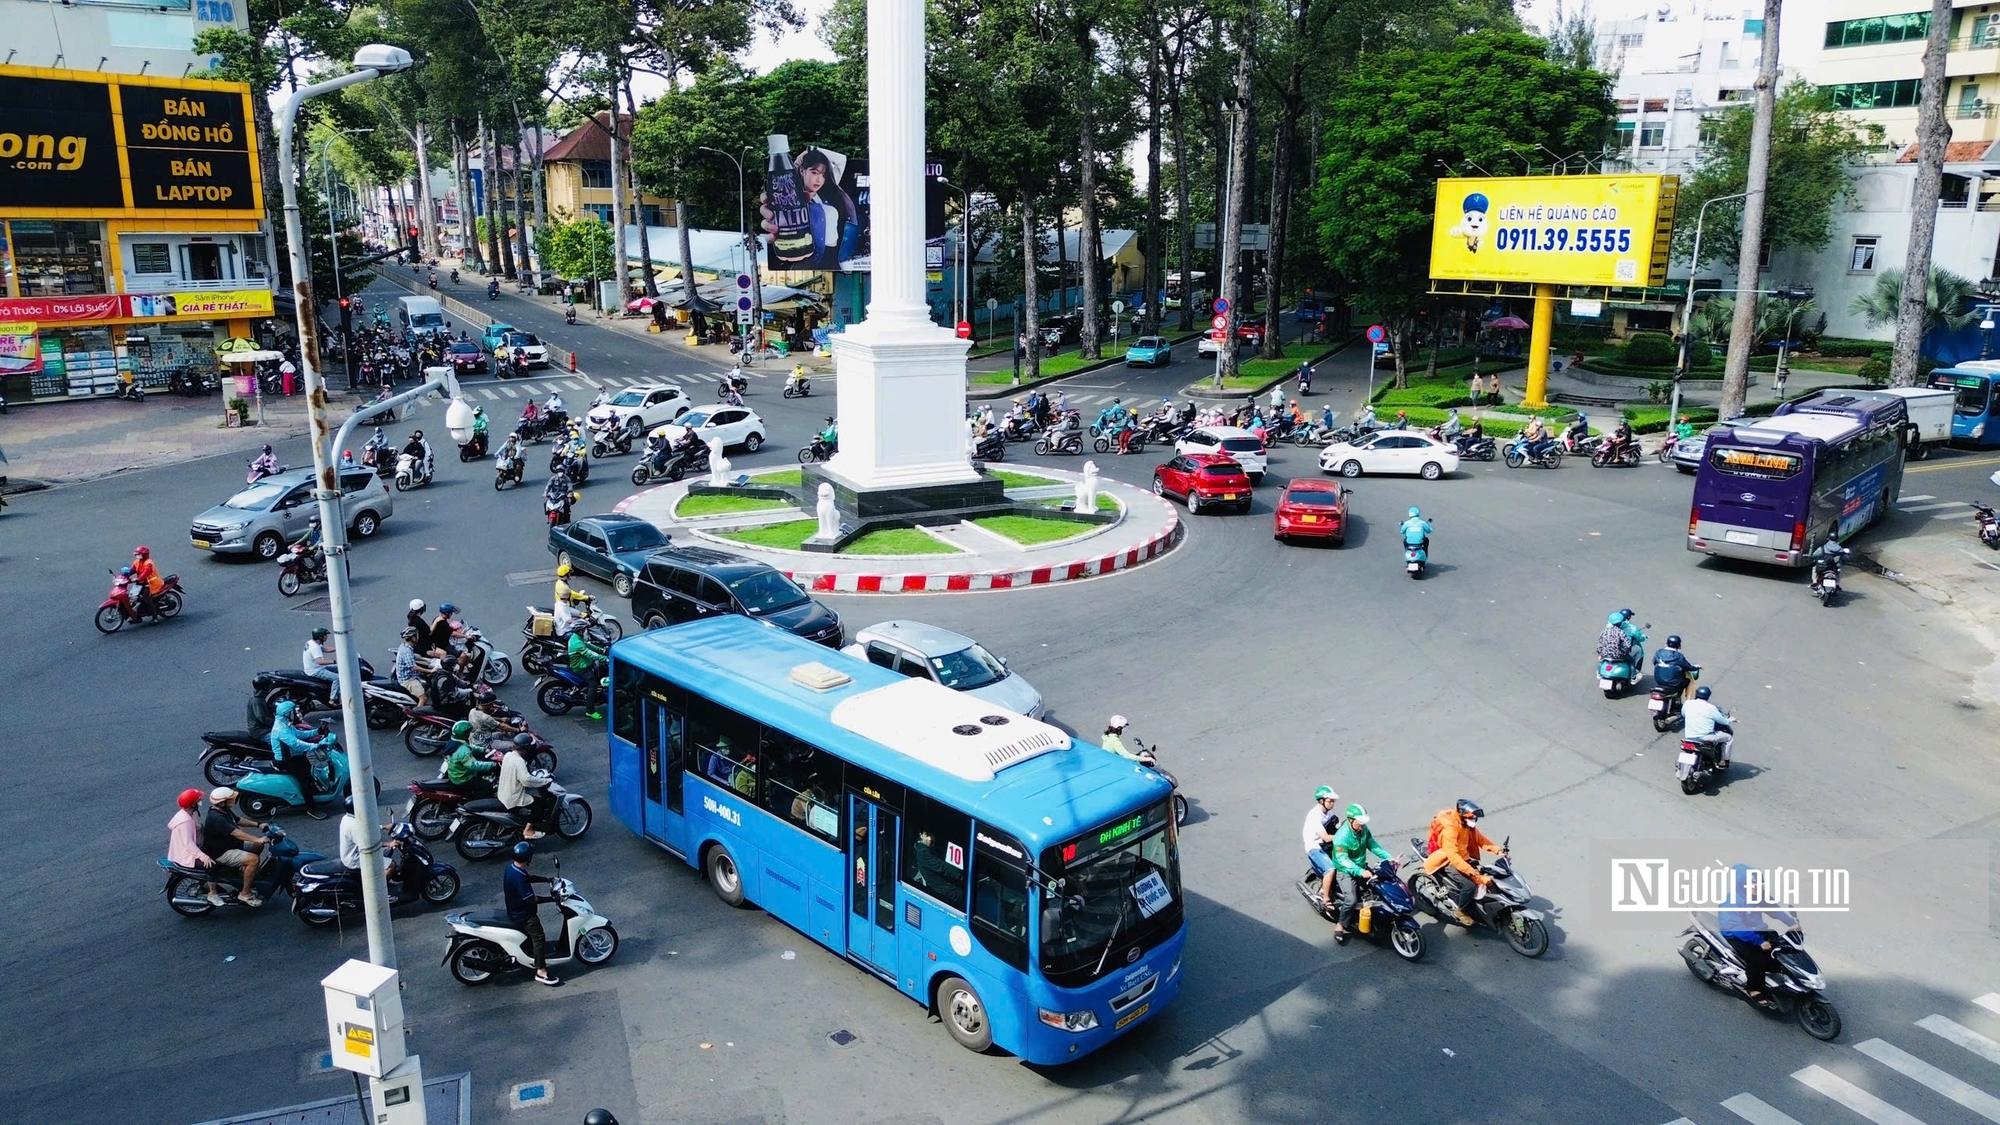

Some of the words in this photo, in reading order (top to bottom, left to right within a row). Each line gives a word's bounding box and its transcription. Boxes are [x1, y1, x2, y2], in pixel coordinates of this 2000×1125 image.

[164, 97, 206, 117] BÁN
[141, 118, 201, 142] ĐỒNG
[204, 122, 233, 143] HỒ
[10, 161, 52, 170] .com
[170, 158, 212, 177] BÁN
[156, 185, 233, 201] LAPTOP
[1499, 205, 1524, 220] LIÊN
[1528, 205, 1543, 223] HỆ
[1547, 205, 1588, 220] QUẢNG
[1592, 205, 1617, 220] CÁO
[1497, 228, 1630, 252] 0911.39.5555
[12, 305, 42, 315] Trước
[53, 305, 69, 313] 0%
[70, 303, 85, 312] Lãi
[86, 302, 109, 312] Suất
[182, 303, 200, 312] GIÁ
[202, 302, 215, 311] RẺ
[218, 301, 248, 311] THẬT!
[703, 796, 741, 826] 50H-400.31
[949, 846, 962, 866] 10
